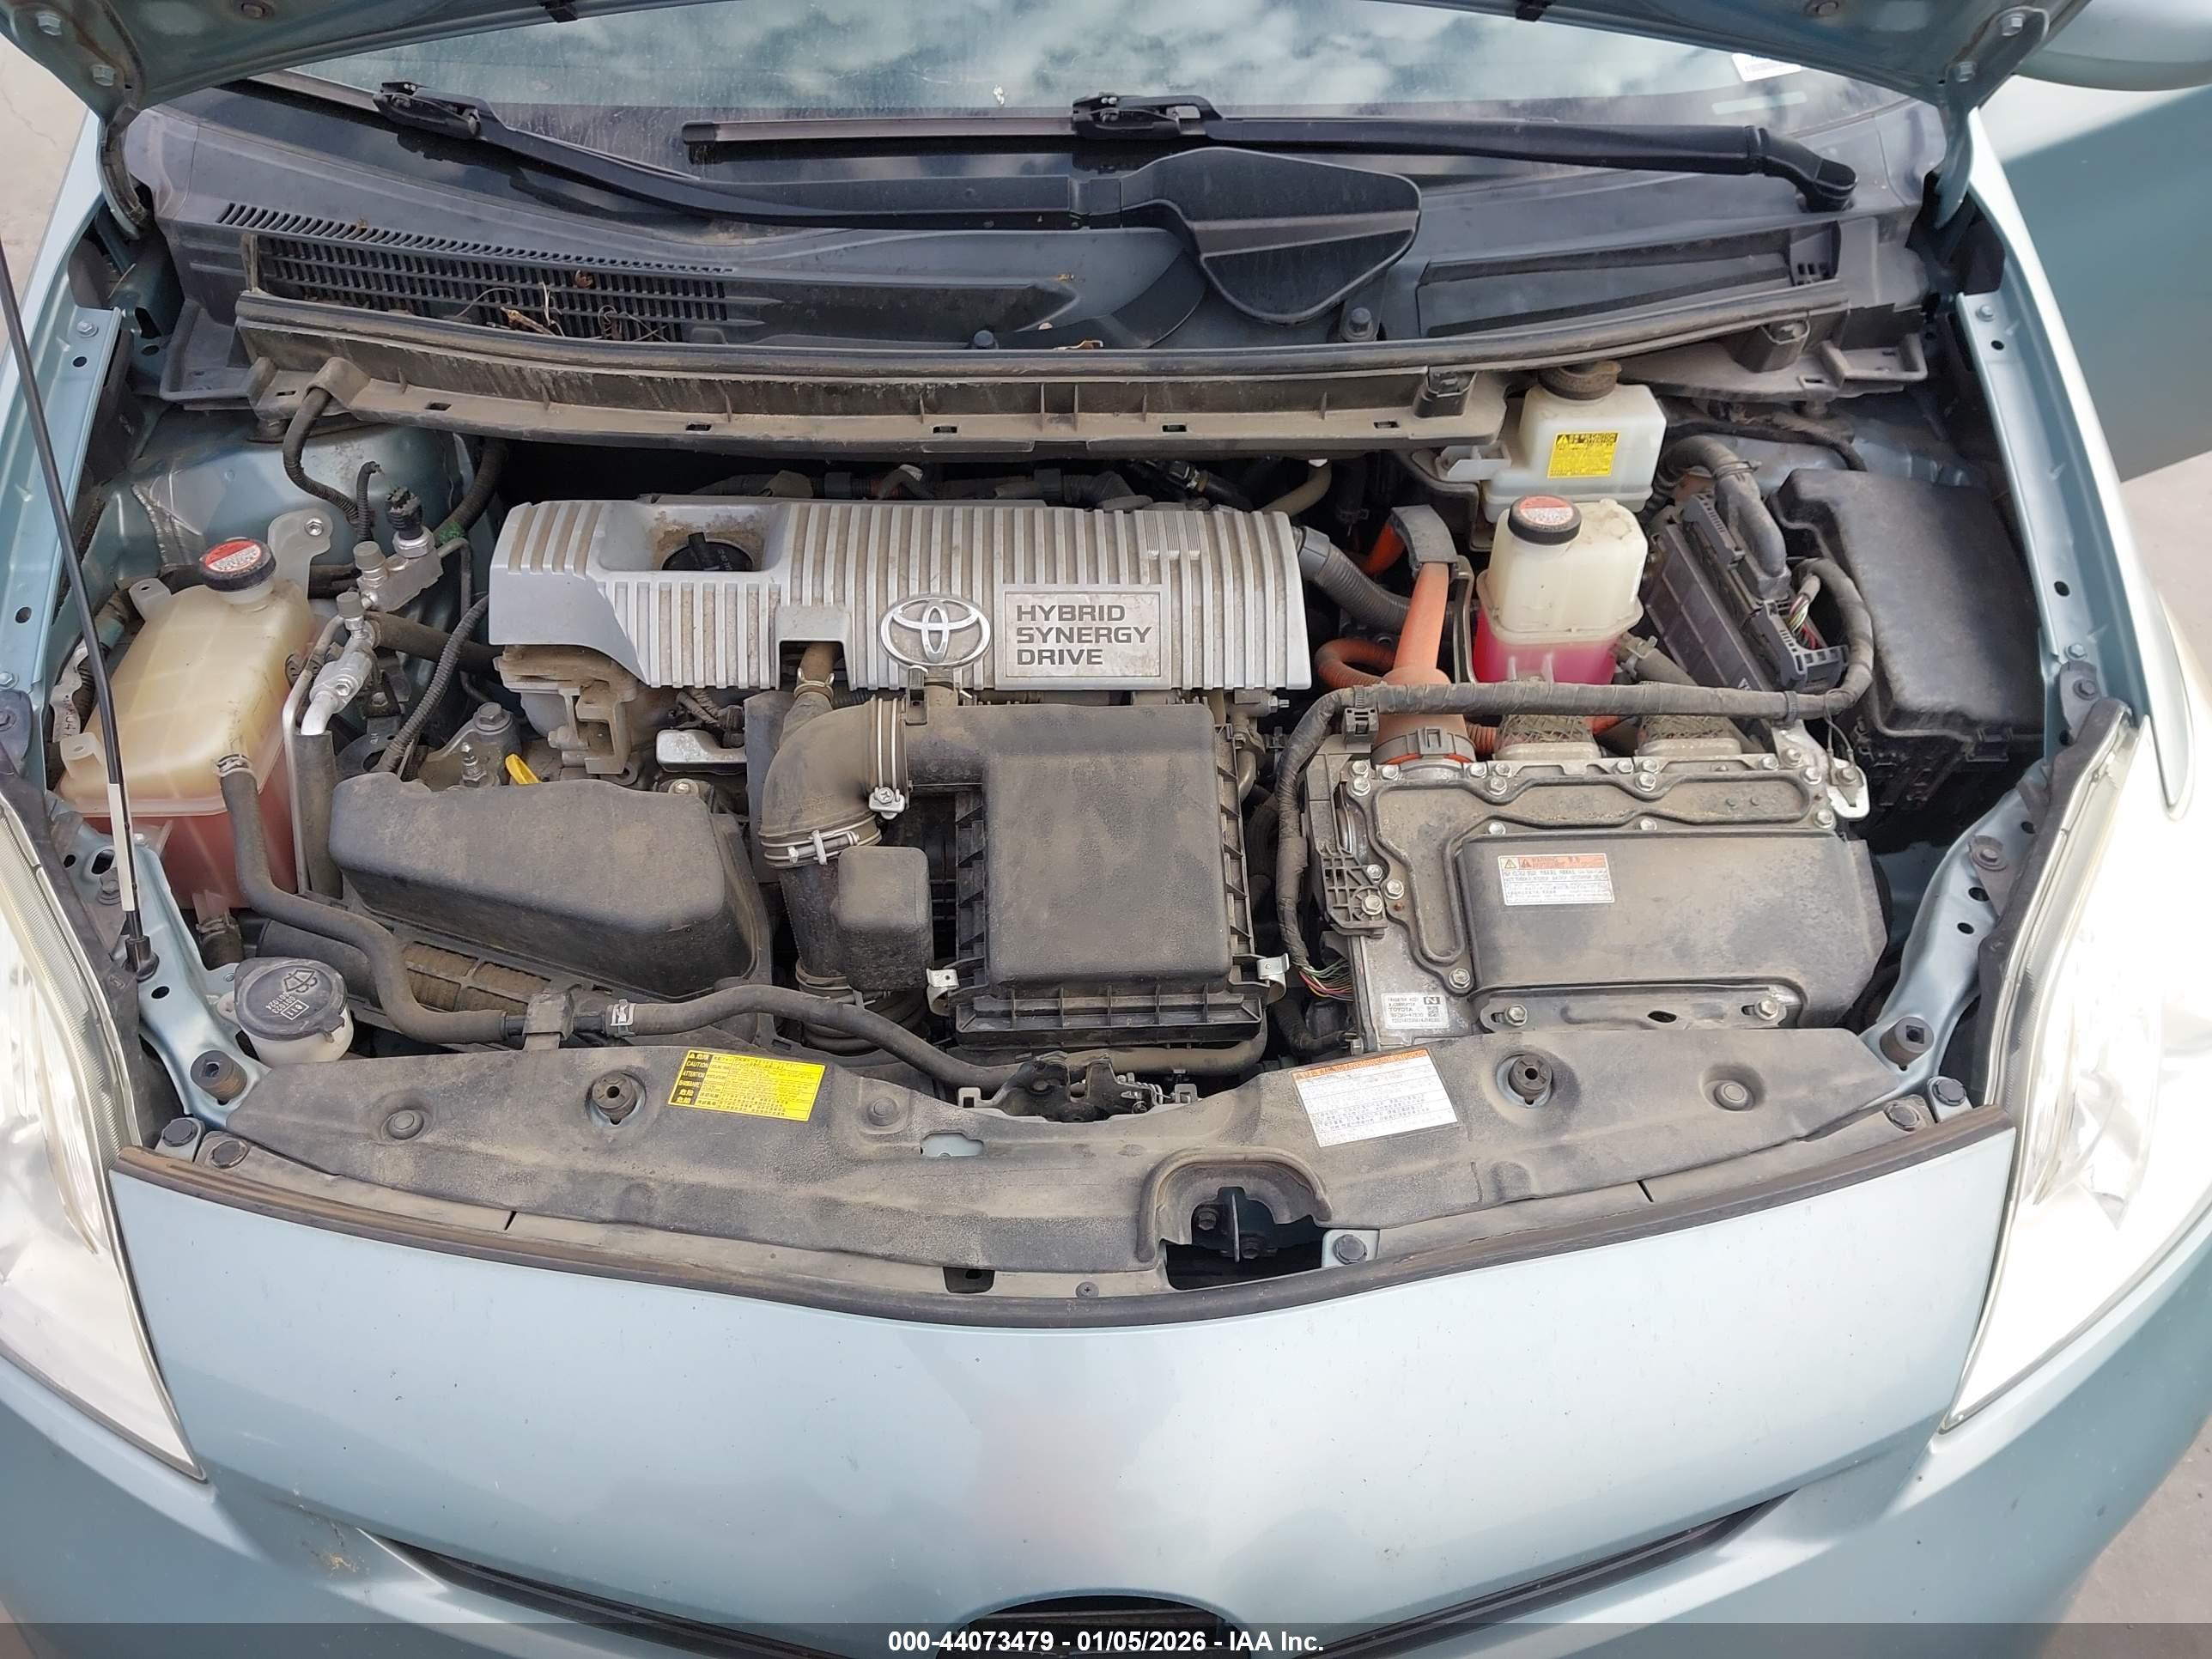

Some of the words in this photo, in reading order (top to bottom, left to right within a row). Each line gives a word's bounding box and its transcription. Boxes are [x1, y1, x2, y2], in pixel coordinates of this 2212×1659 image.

[1017, 605, 1125, 621] HYBRID
[1017, 627, 1152, 643] SYNERGY
[1017, 649, 1103, 665] DRIVE
